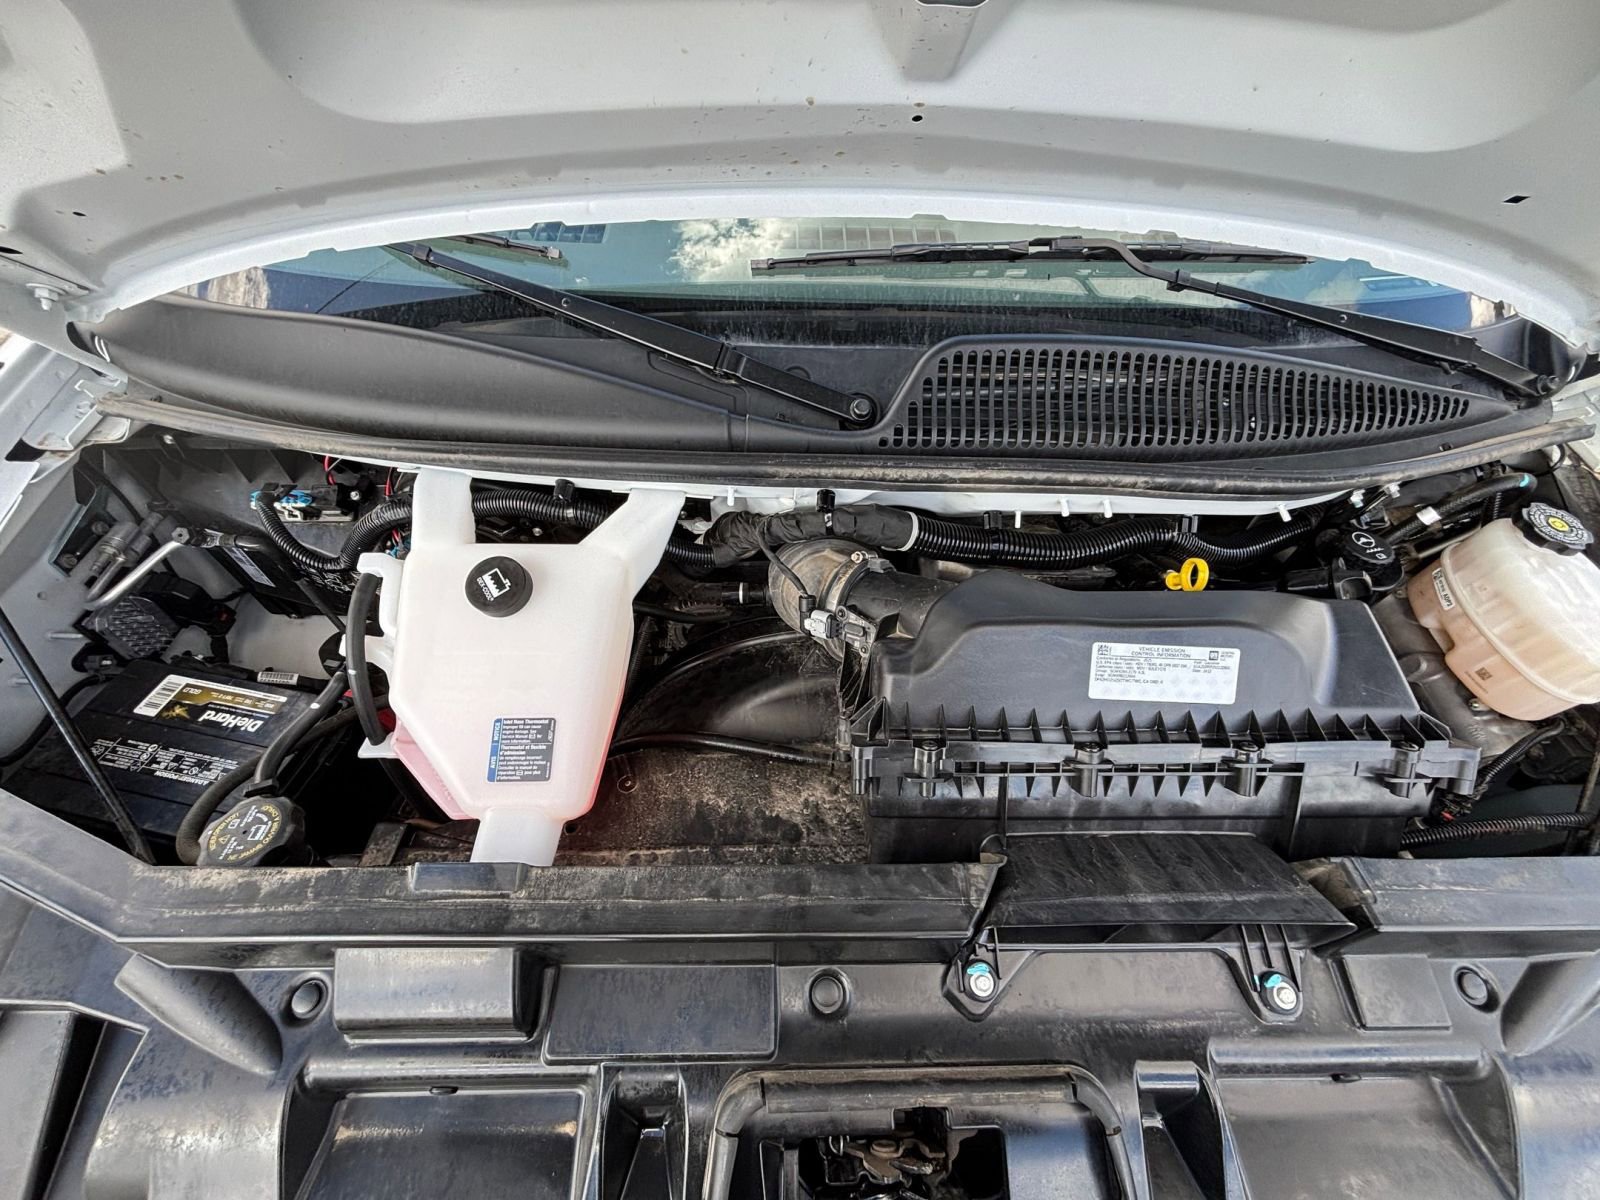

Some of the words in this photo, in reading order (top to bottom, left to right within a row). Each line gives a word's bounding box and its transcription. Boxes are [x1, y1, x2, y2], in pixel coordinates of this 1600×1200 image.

[182, 686, 202, 695] GOLD
[198, 709, 264, 732] DieHard
[493, 722, 501, 741] NOTICE
